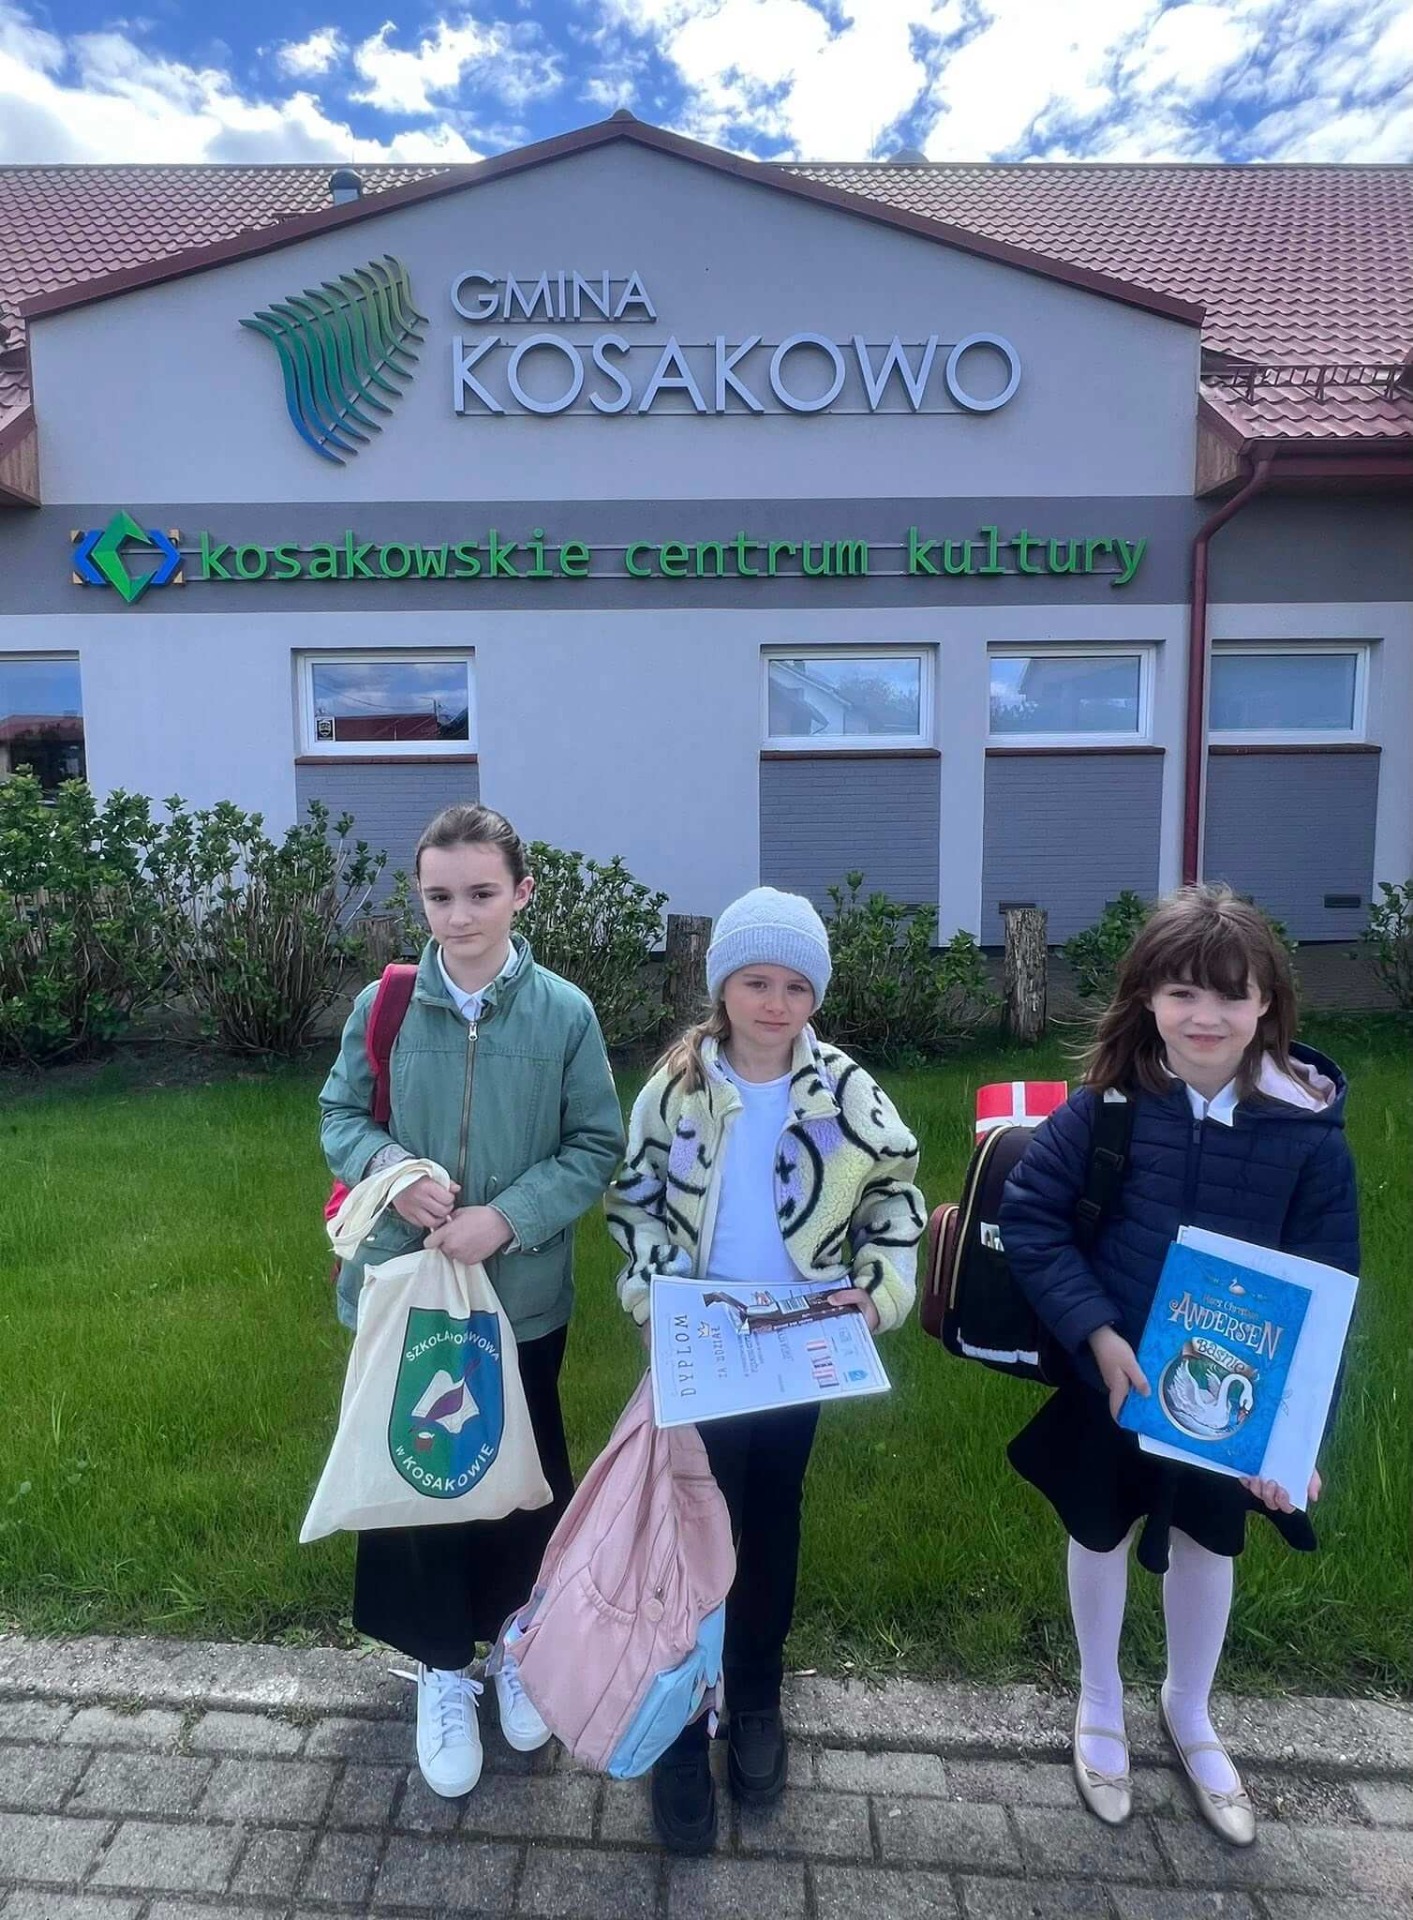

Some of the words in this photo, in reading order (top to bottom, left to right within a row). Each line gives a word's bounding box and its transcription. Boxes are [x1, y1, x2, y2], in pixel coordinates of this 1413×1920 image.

[451, 270, 657, 322] GMINA
[453, 332, 1022, 414] KOSAKOWO
[201, 528, 591, 580] kosakowskie
[624, 531, 868, 577] centrum
[908, 526, 1147, 586] kultury
[406, 1330, 450, 1362] SZKOŁA
[674, 1314, 697, 1397] DYPLOM
[1168, 1291, 1284, 1360] ANDERSEN
[402, 1442, 495, 1492] KOSAKOWIE
